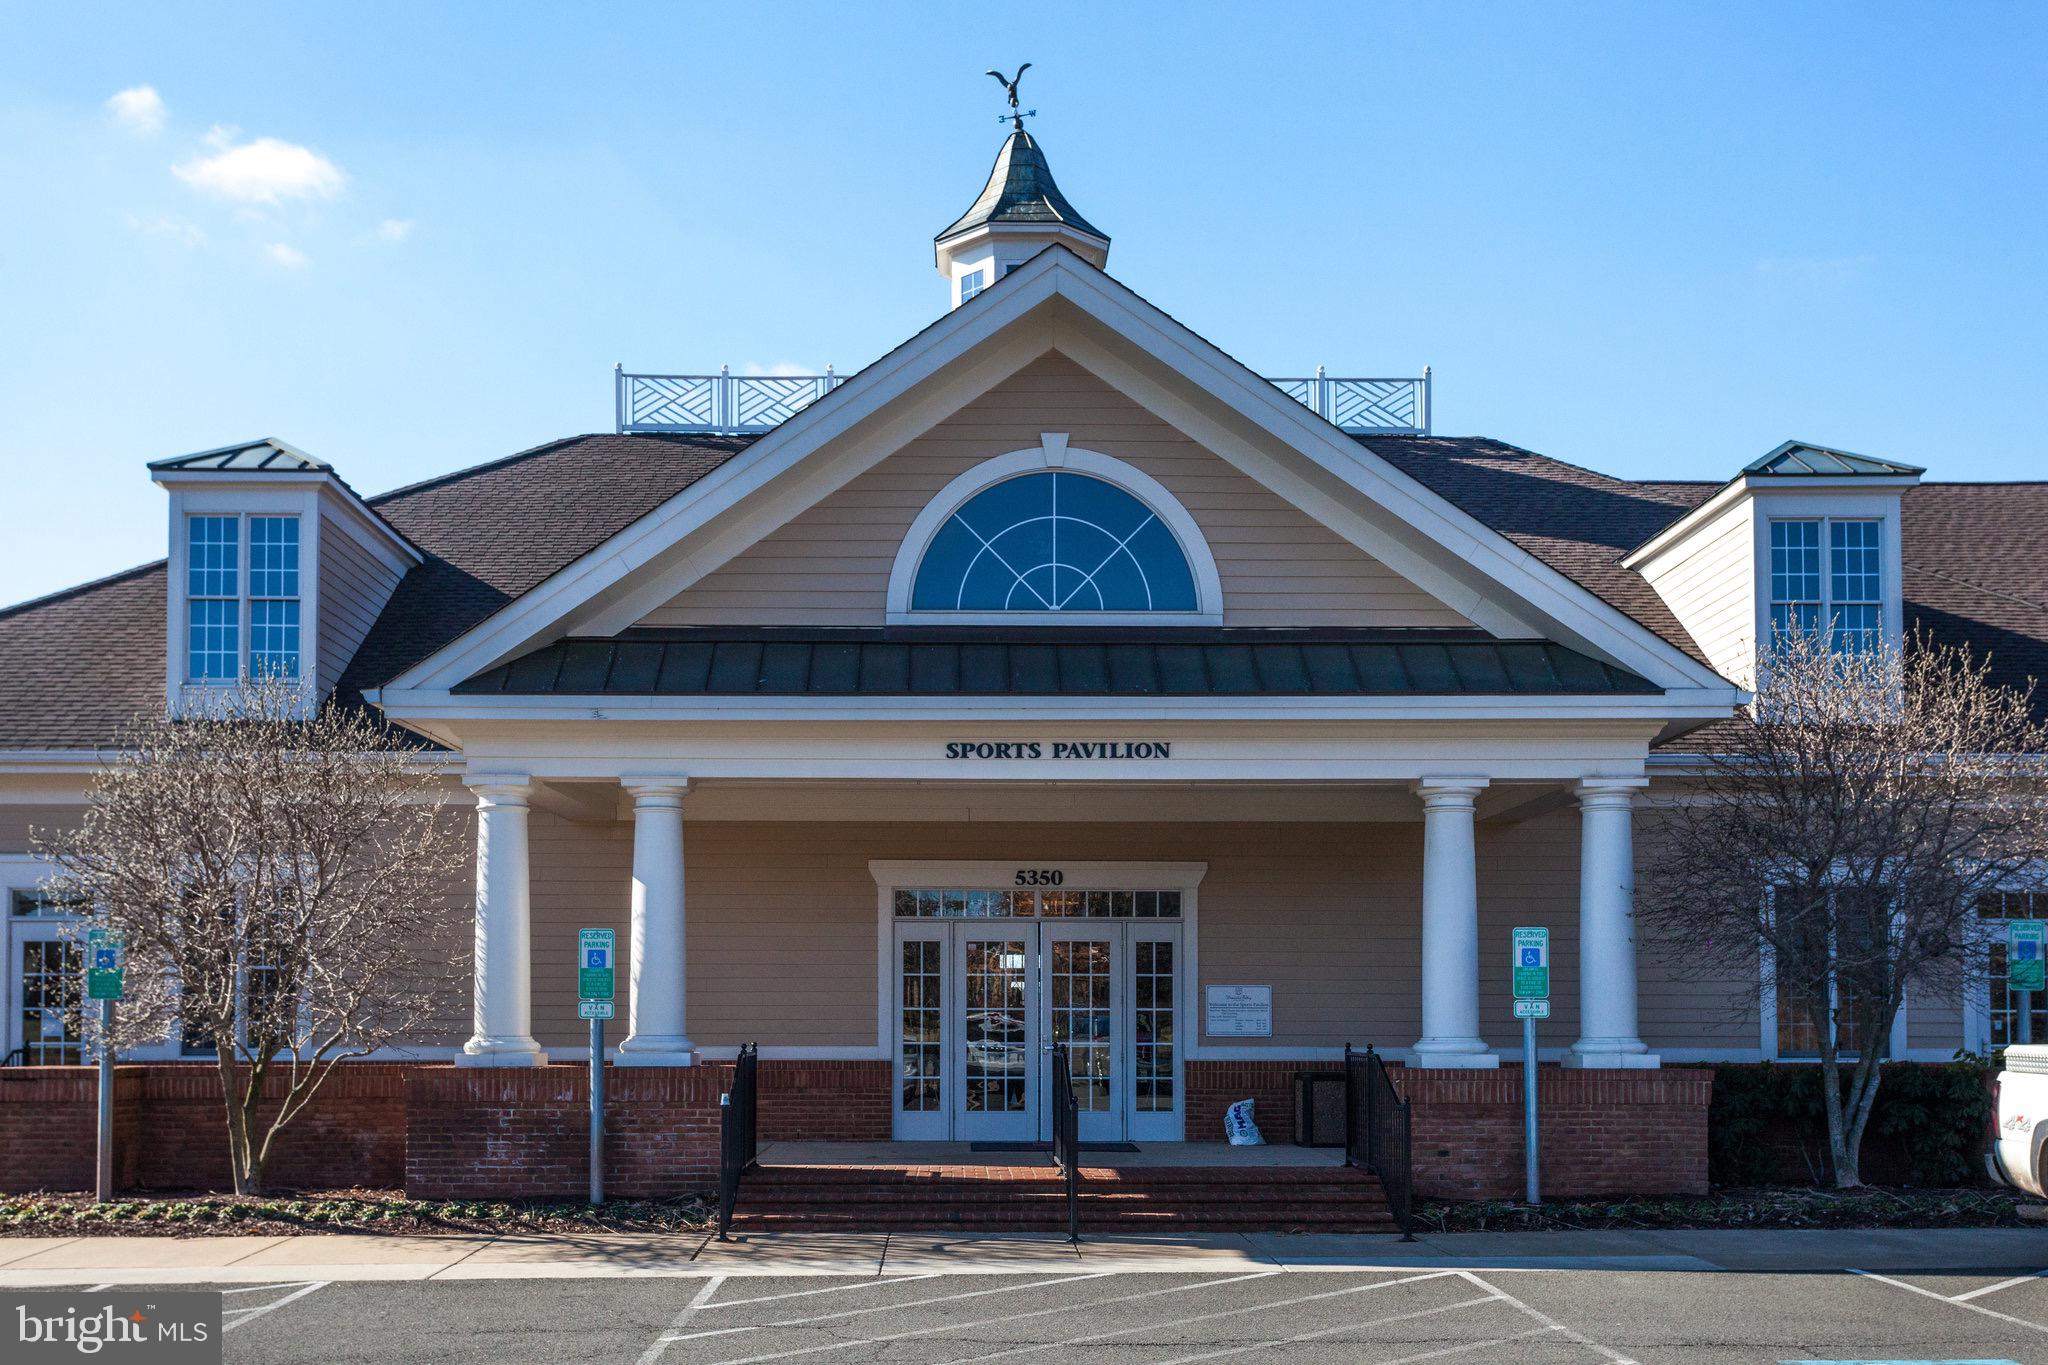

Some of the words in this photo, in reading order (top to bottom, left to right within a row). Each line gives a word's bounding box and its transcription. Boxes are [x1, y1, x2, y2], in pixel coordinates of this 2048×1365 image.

[946, 742, 1042, 759] SPORTS
[1052, 742, 1171, 759] PAVILION
[1014, 870, 1064, 886] 5350
[582, 932, 612, 940] RESERVED
[1515, 930, 1546, 938] RESERVED
[2014, 932, 2039, 940] PARKING
[584, 941, 609, 949] PARKING
[1518, 939, 1543, 947] PARKING
